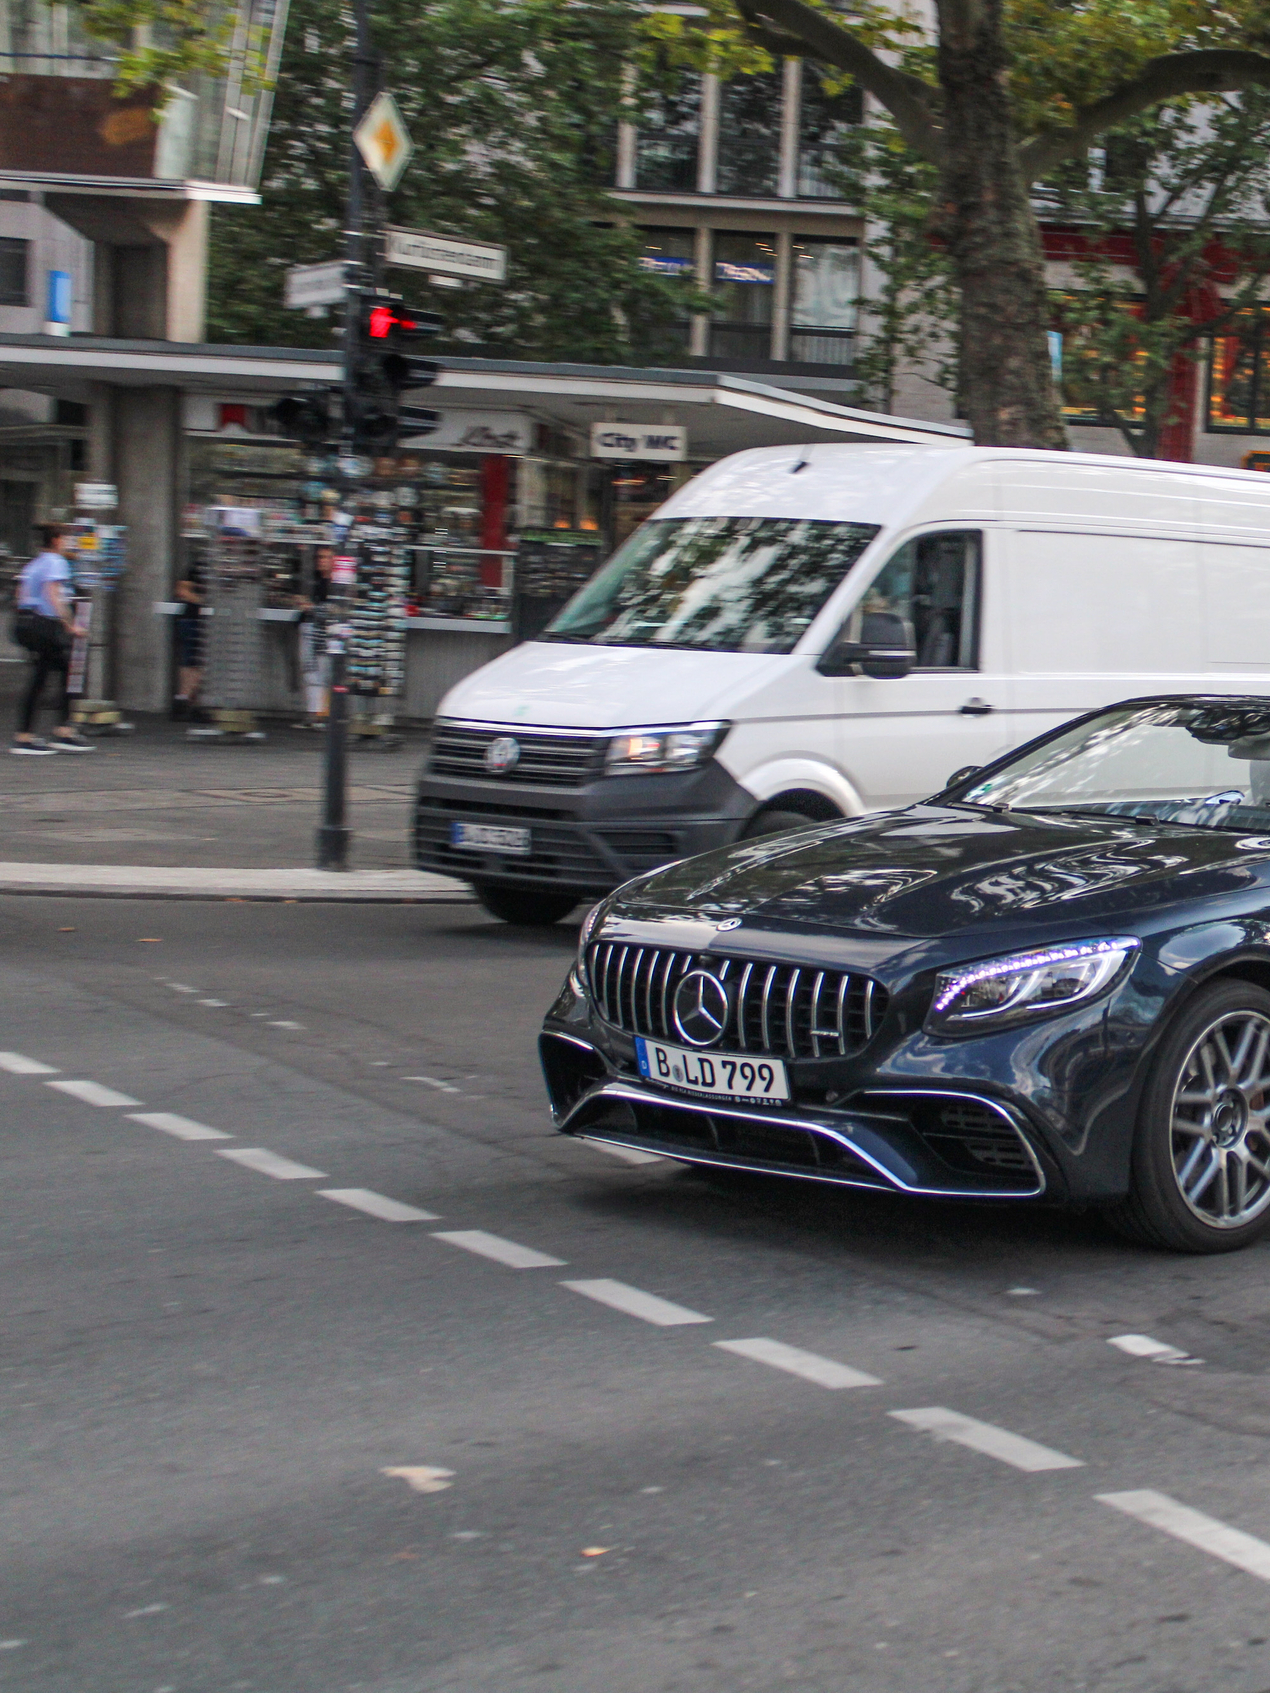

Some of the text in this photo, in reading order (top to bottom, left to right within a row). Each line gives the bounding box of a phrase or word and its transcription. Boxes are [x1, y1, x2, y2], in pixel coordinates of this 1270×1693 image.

[600, 432, 680, 452] City WC
[655, 1047, 775, 1093] B LD 799
